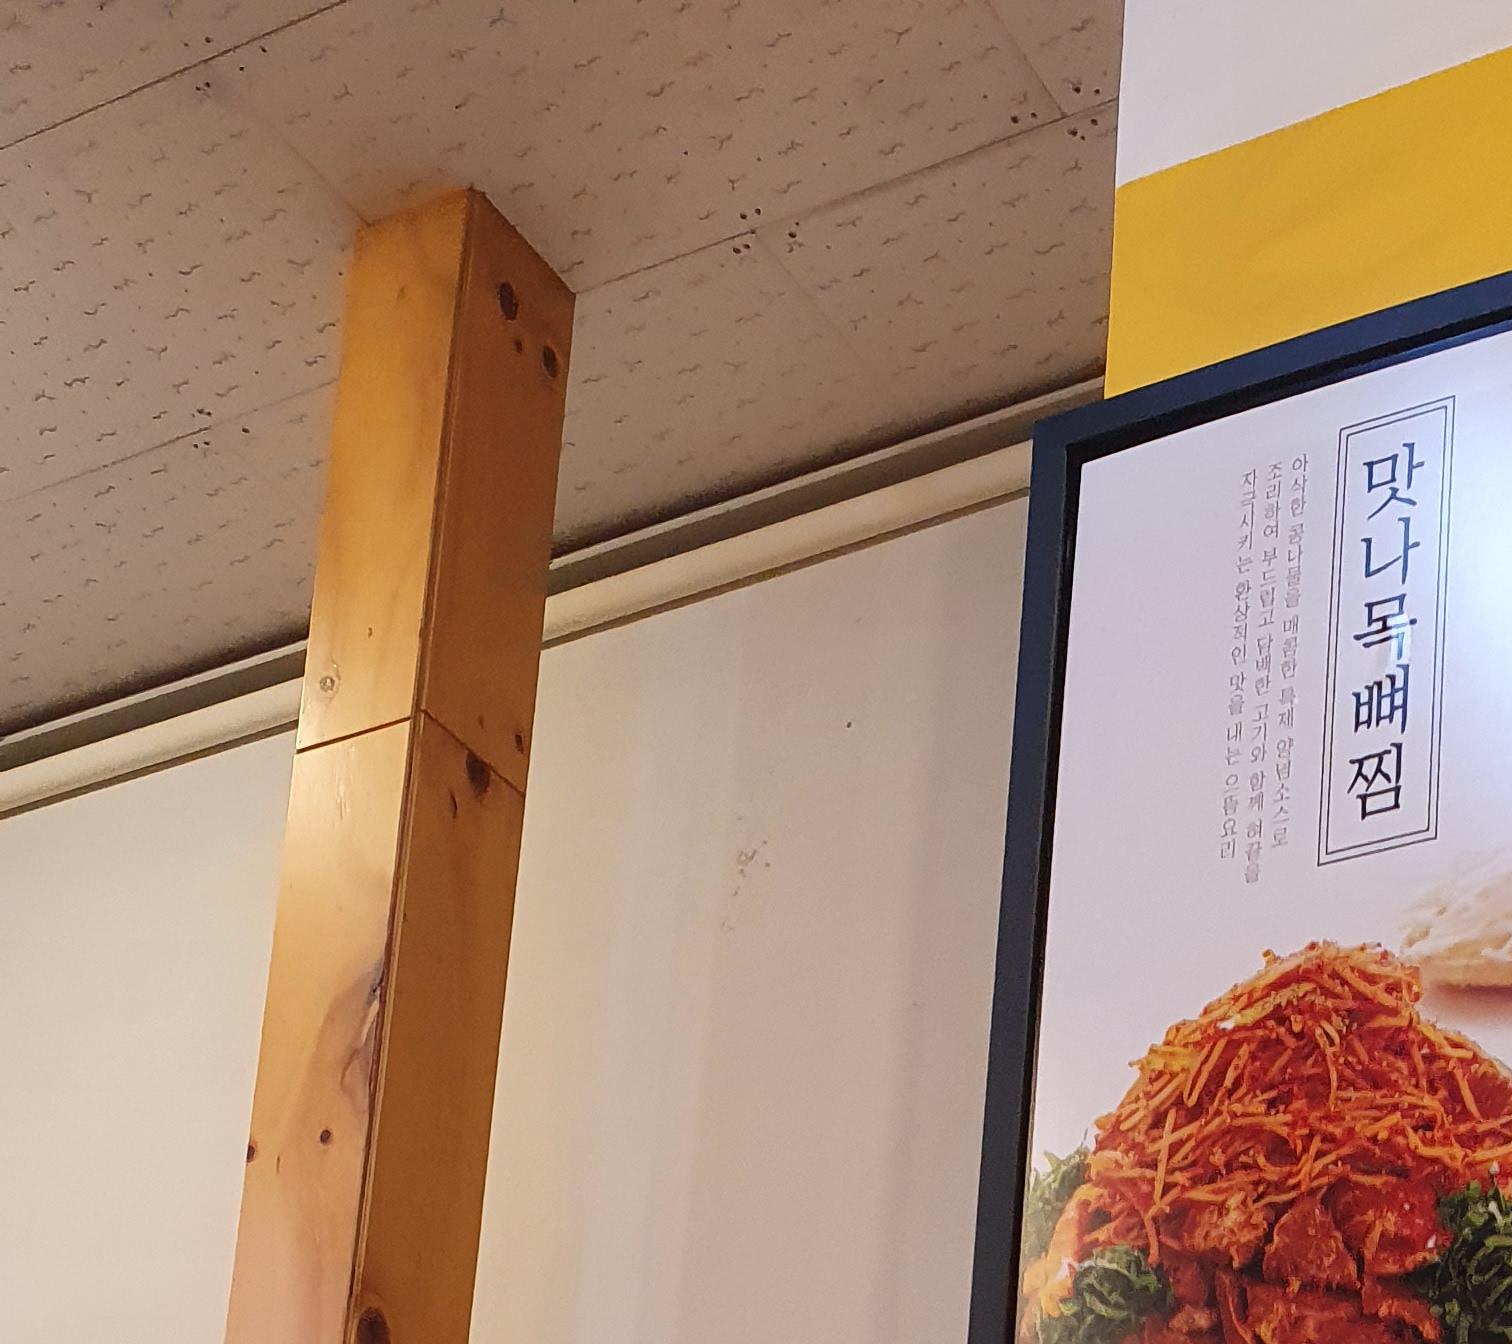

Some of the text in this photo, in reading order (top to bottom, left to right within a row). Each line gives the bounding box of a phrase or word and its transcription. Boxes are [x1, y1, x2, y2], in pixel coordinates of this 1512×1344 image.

[1263, 461, 1283, 539] 조리하여
[1288, 453, 1309, 518] 아삭한
[1235, 468, 1257, 575] 자극시키는
[1258, 546, 1279, 628] 부드럽고
[1284, 523, 1305, 608] 콩나물을
[1230, 579, 1252, 666] 환상적인
[1280, 614, 1299, 679] 매콤한
[1227, 671, 1246, 716] 맛을
[1254, 632, 1274, 696] 담백한
[1224, 721, 1243, 767] 내는
[1250, 703, 1269, 764] 고기와
[1247, 769, 1266, 812] 함께
